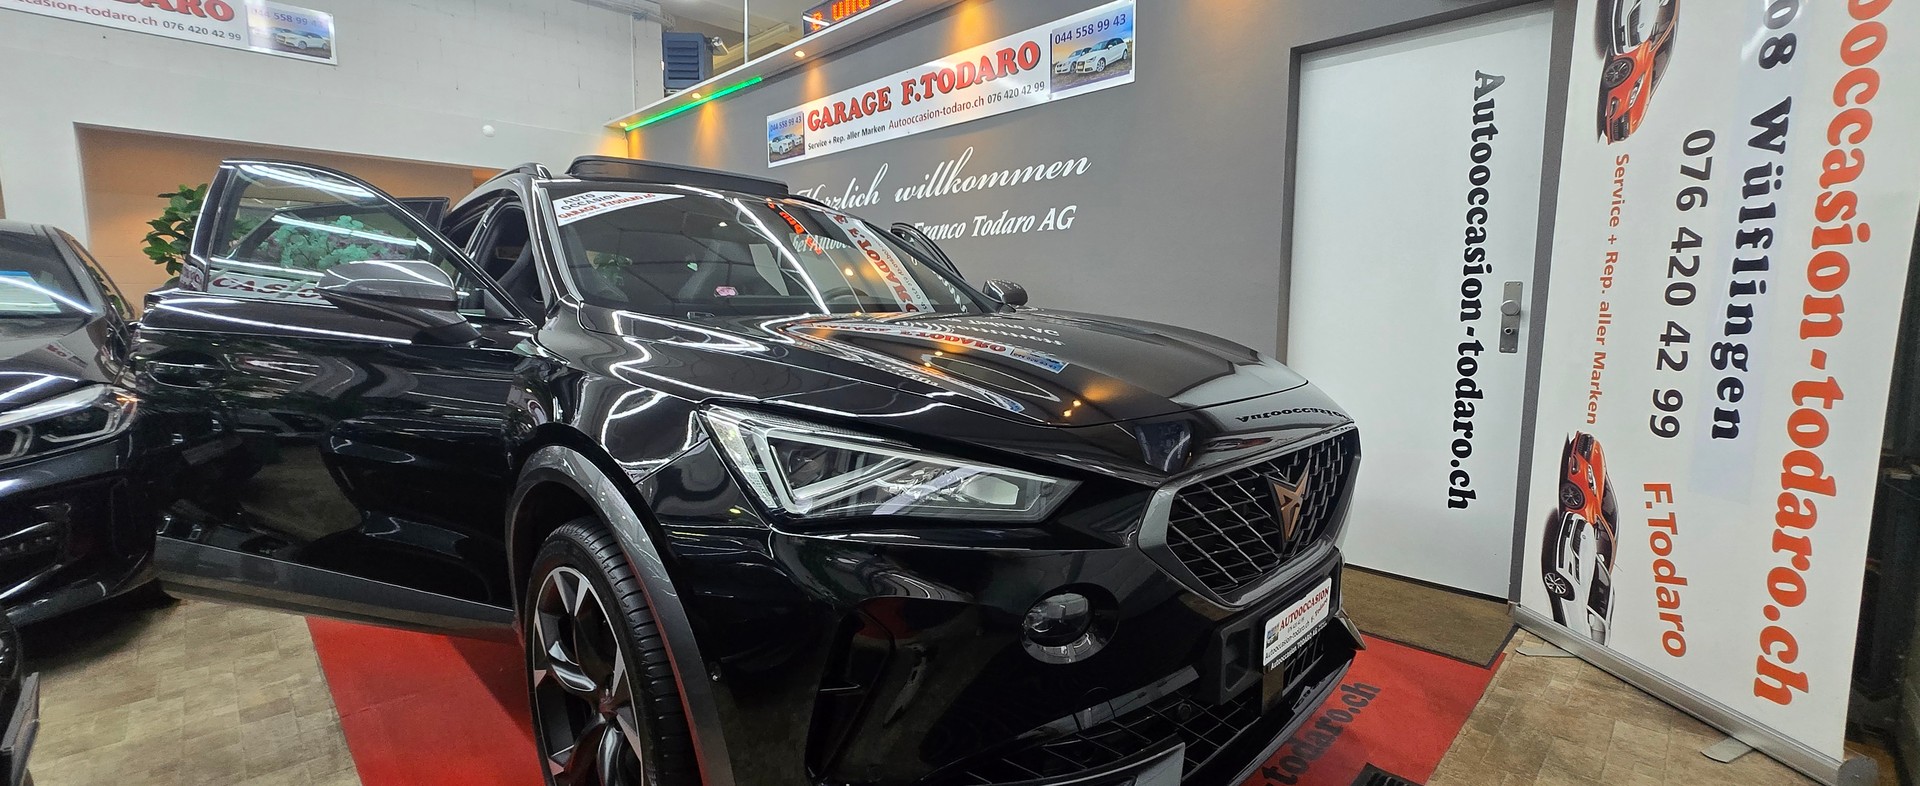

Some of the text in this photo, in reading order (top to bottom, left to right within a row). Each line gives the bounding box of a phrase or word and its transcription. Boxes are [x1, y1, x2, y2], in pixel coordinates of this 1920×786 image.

[162, 20, 185, 31] 076
[188, 25, 209, 36] 420
[212, 29, 226, 39] 42
[228, 32, 242, 41] 99
[273, 12, 293, 22] 558
[295, 17, 308, 25] 99
[1054, 13, 1127, 45] 044 558 99 43
[807, 40, 1041, 132] GARAGE F.TODARO
[808, 139, 828, 150] Service
[832, 135, 846, 145] Rep.
[847, 130, 861, 140] aller
[861, 124, 886, 137] Marken
[889, 95, 985, 130] Autooccasion-todaro.ch
[987, 91, 1002, 104] 076
[1004, 86, 1019, 100] 420
[1021, 83, 1033, 96] 42
[1034, 80, 1045, 93] 99
[561, 193, 620, 211] OCCASION
[563, 193, 596, 205] AUTO
[796, 146, 1091, 211] Hrzlich willkommen
[1609, 153, 1630, 228] Service
[914, 221, 967, 241] Franco
[971, 209, 1036, 238] Todaro
[1037, 205, 1077, 232] AG
[1447, 69, 1505, 509] Autooccasion-todaro.ch
[1599, 251, 1619, 294] Rep.
[1649, 129, 1716, 438] 076 420 42 99
[1710, 95, 1793, 440] Wülflingen
[1596, 301, 1612, 346] aller
[1586, 351, 1607, 425] Marken
[1643, 482, 1688, 657] F.Todaro
[1280, 586, 1330, 630] AUTOOCCASION
